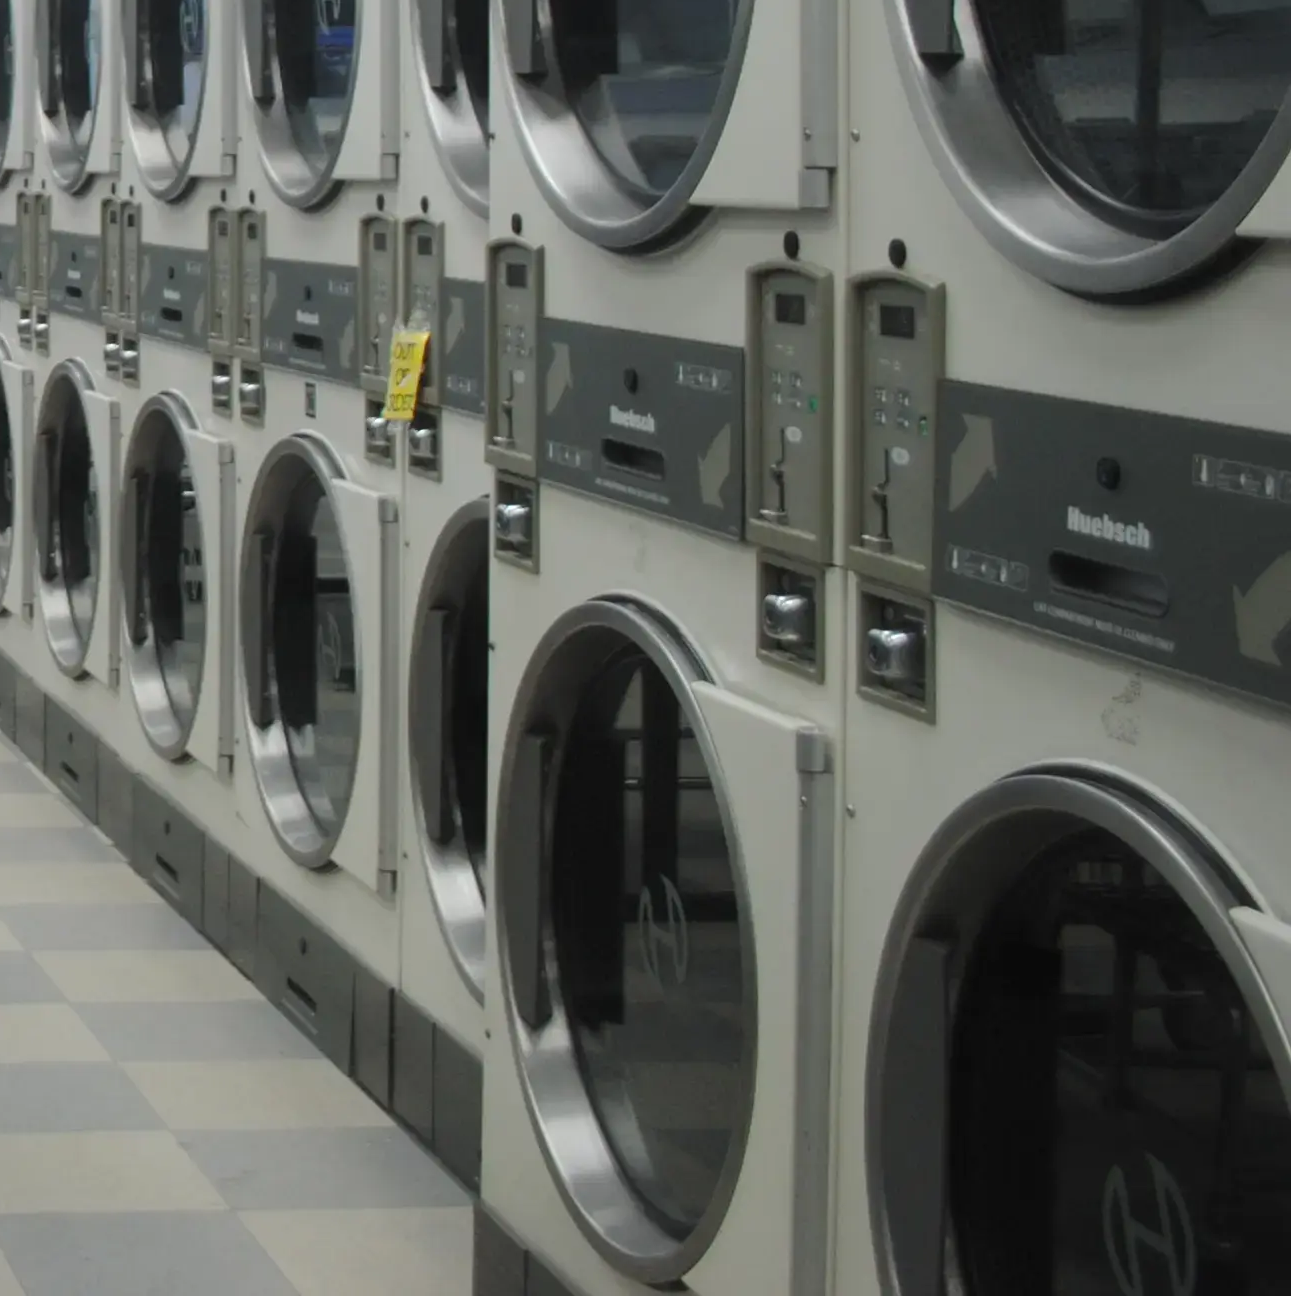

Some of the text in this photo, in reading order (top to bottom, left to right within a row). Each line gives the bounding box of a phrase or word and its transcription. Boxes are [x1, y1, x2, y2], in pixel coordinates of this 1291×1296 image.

[394, 342, 417, 360] OUT
[395, 368, 411, 386] OF
[1067, 505, 1151, 549] Huebsch
